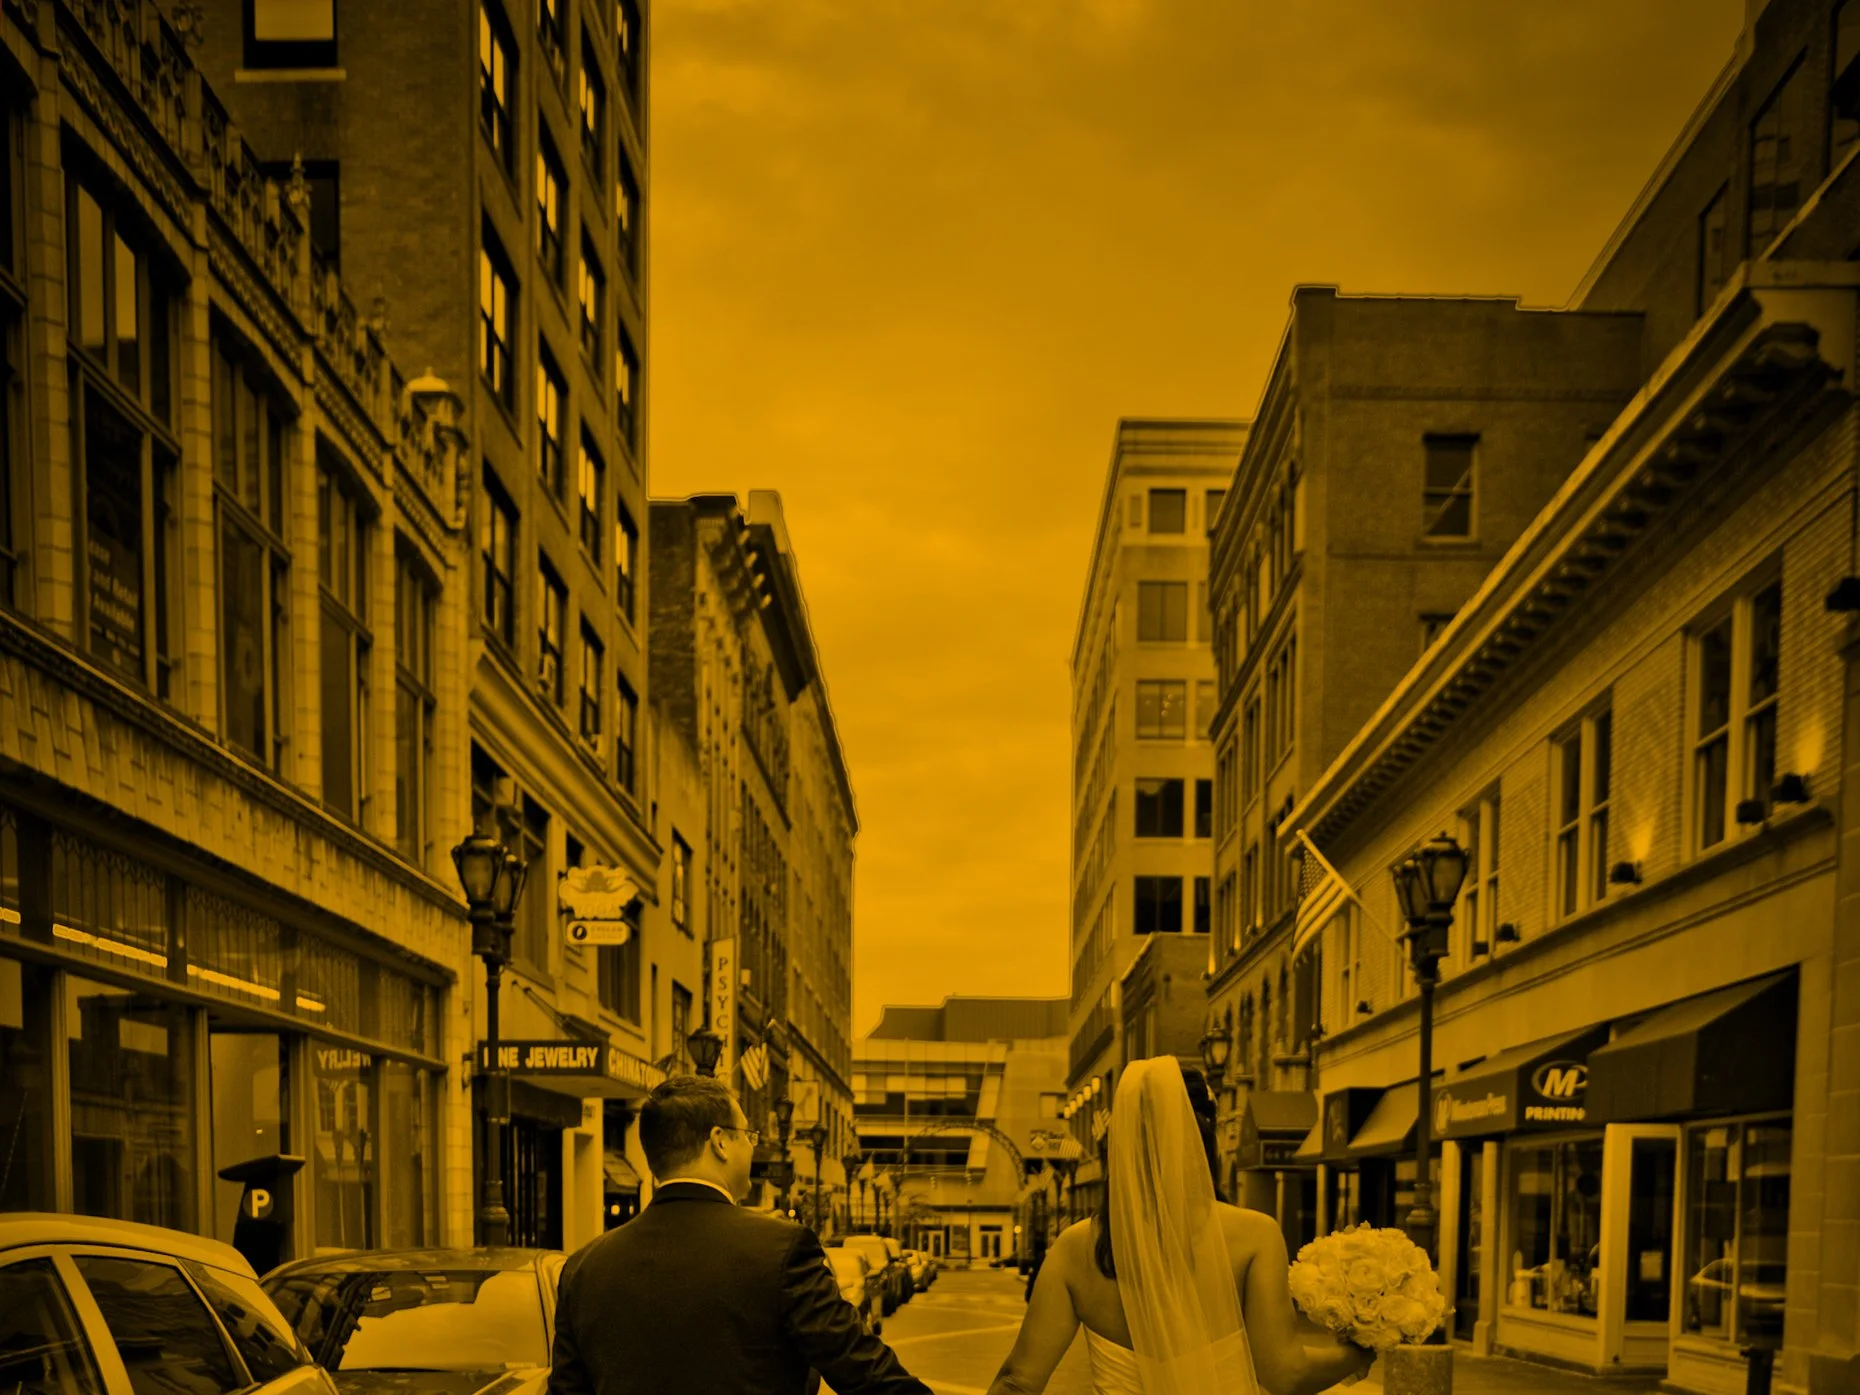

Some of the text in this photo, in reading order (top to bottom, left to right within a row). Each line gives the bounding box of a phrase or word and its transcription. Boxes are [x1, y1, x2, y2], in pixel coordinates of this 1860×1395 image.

[484, 1047, 598, 1069] NE JEWELRY
[252, 1188, 270, 1219] P
